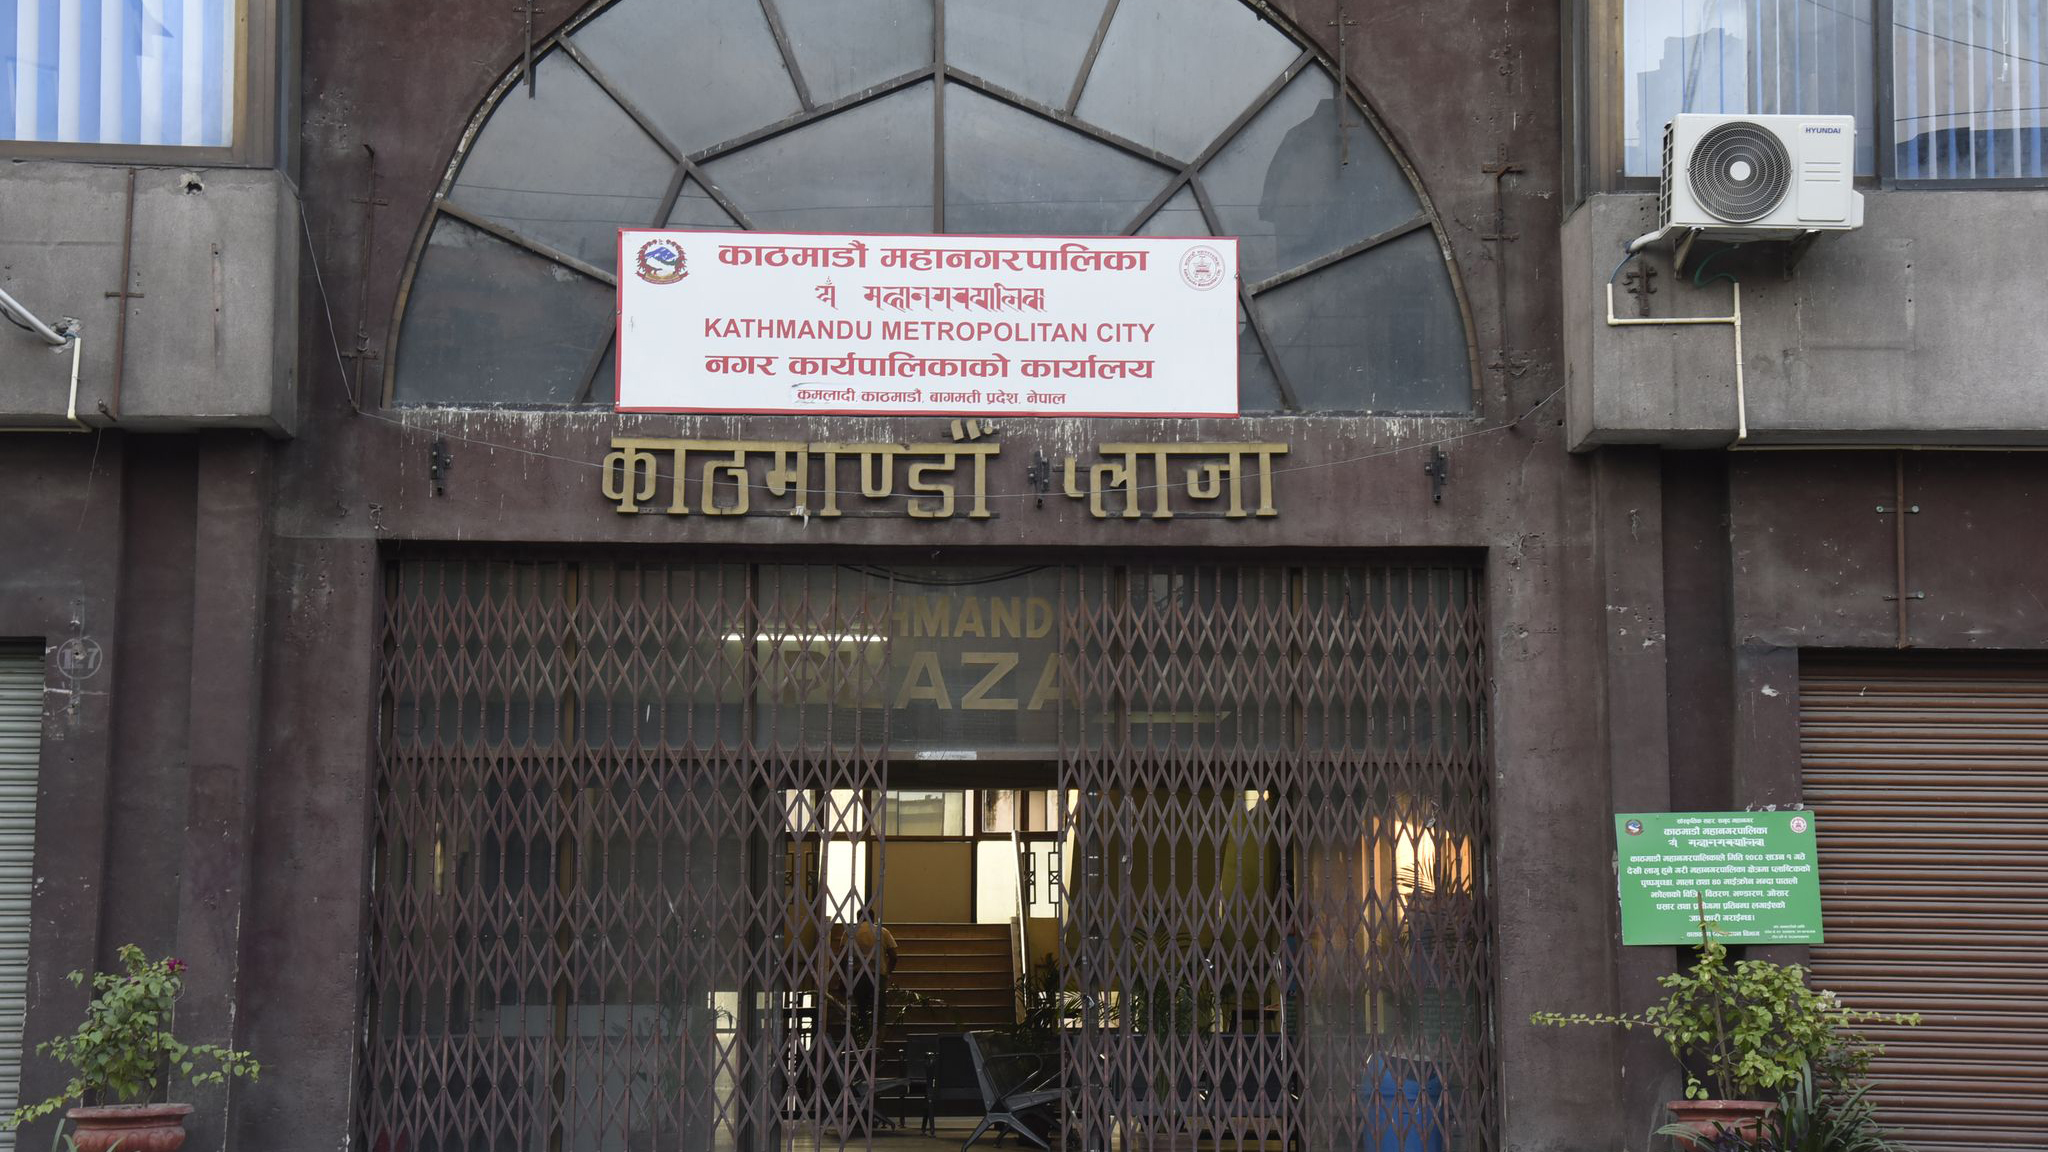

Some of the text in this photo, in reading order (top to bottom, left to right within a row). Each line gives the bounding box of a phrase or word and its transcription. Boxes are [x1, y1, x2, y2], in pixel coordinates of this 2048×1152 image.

[880, 243, 1150, 272] महानगरपालिका
[705, 318, 1155, 343] KATHMANDU METROPOLITAN CITY
[705, 351, 1155, 379] नगर कार्यपालिकाको कार्यालय
[929, 390, 981, 404] बागमती
[1026, 390, 1066, 404] नेपाल
